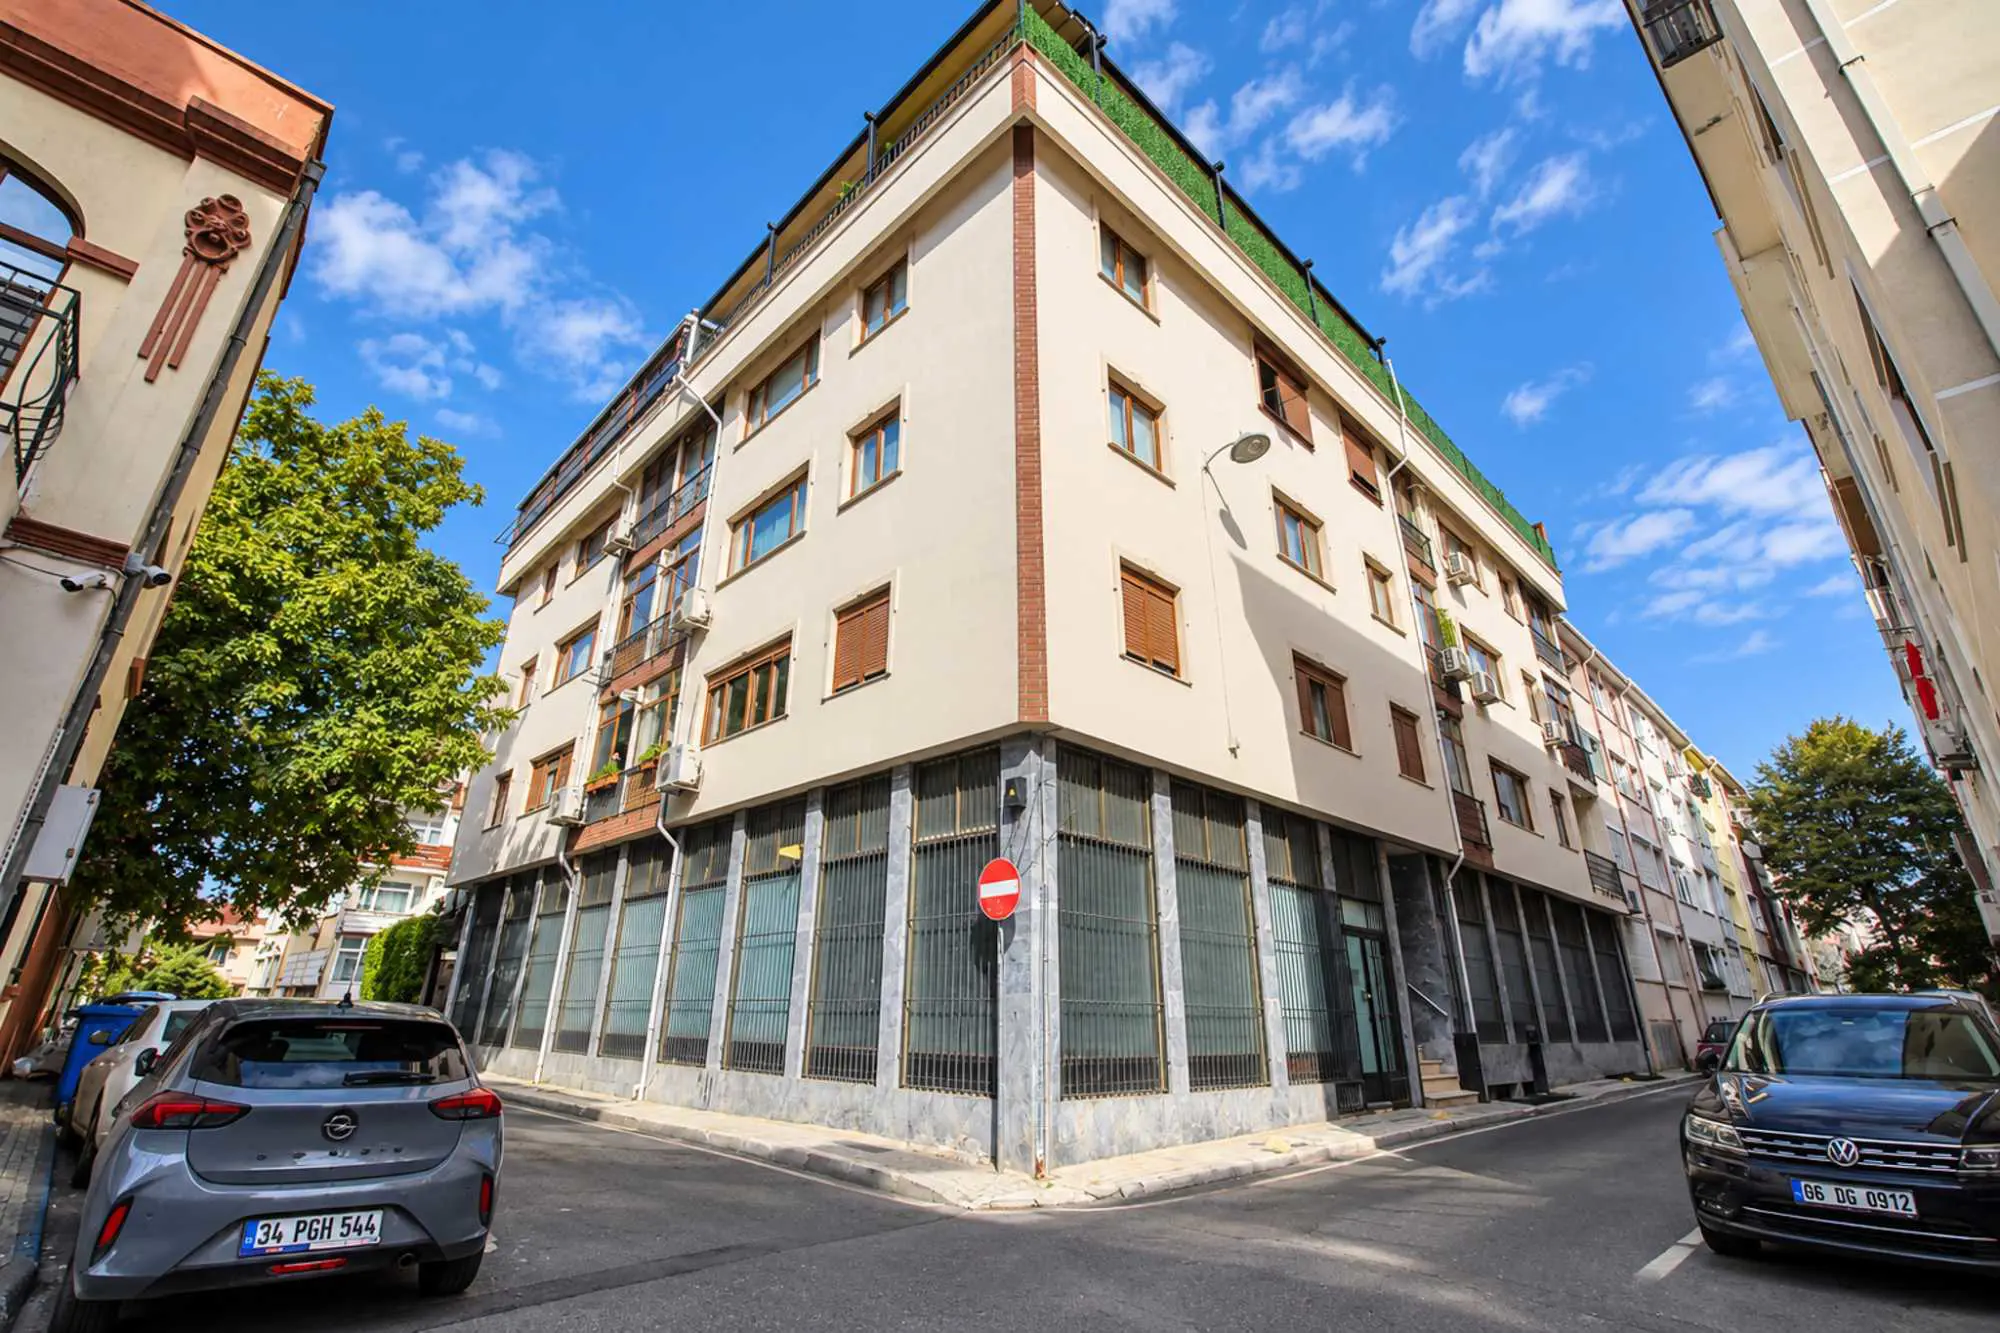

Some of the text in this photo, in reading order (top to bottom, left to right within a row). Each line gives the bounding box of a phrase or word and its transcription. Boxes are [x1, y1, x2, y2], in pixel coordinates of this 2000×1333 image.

[1834, 1187, 1857, 1205] DG
[1866, 1191, 1913, 1212] 0912
[257, 1214, 376, 1245] 34 PGH 544
